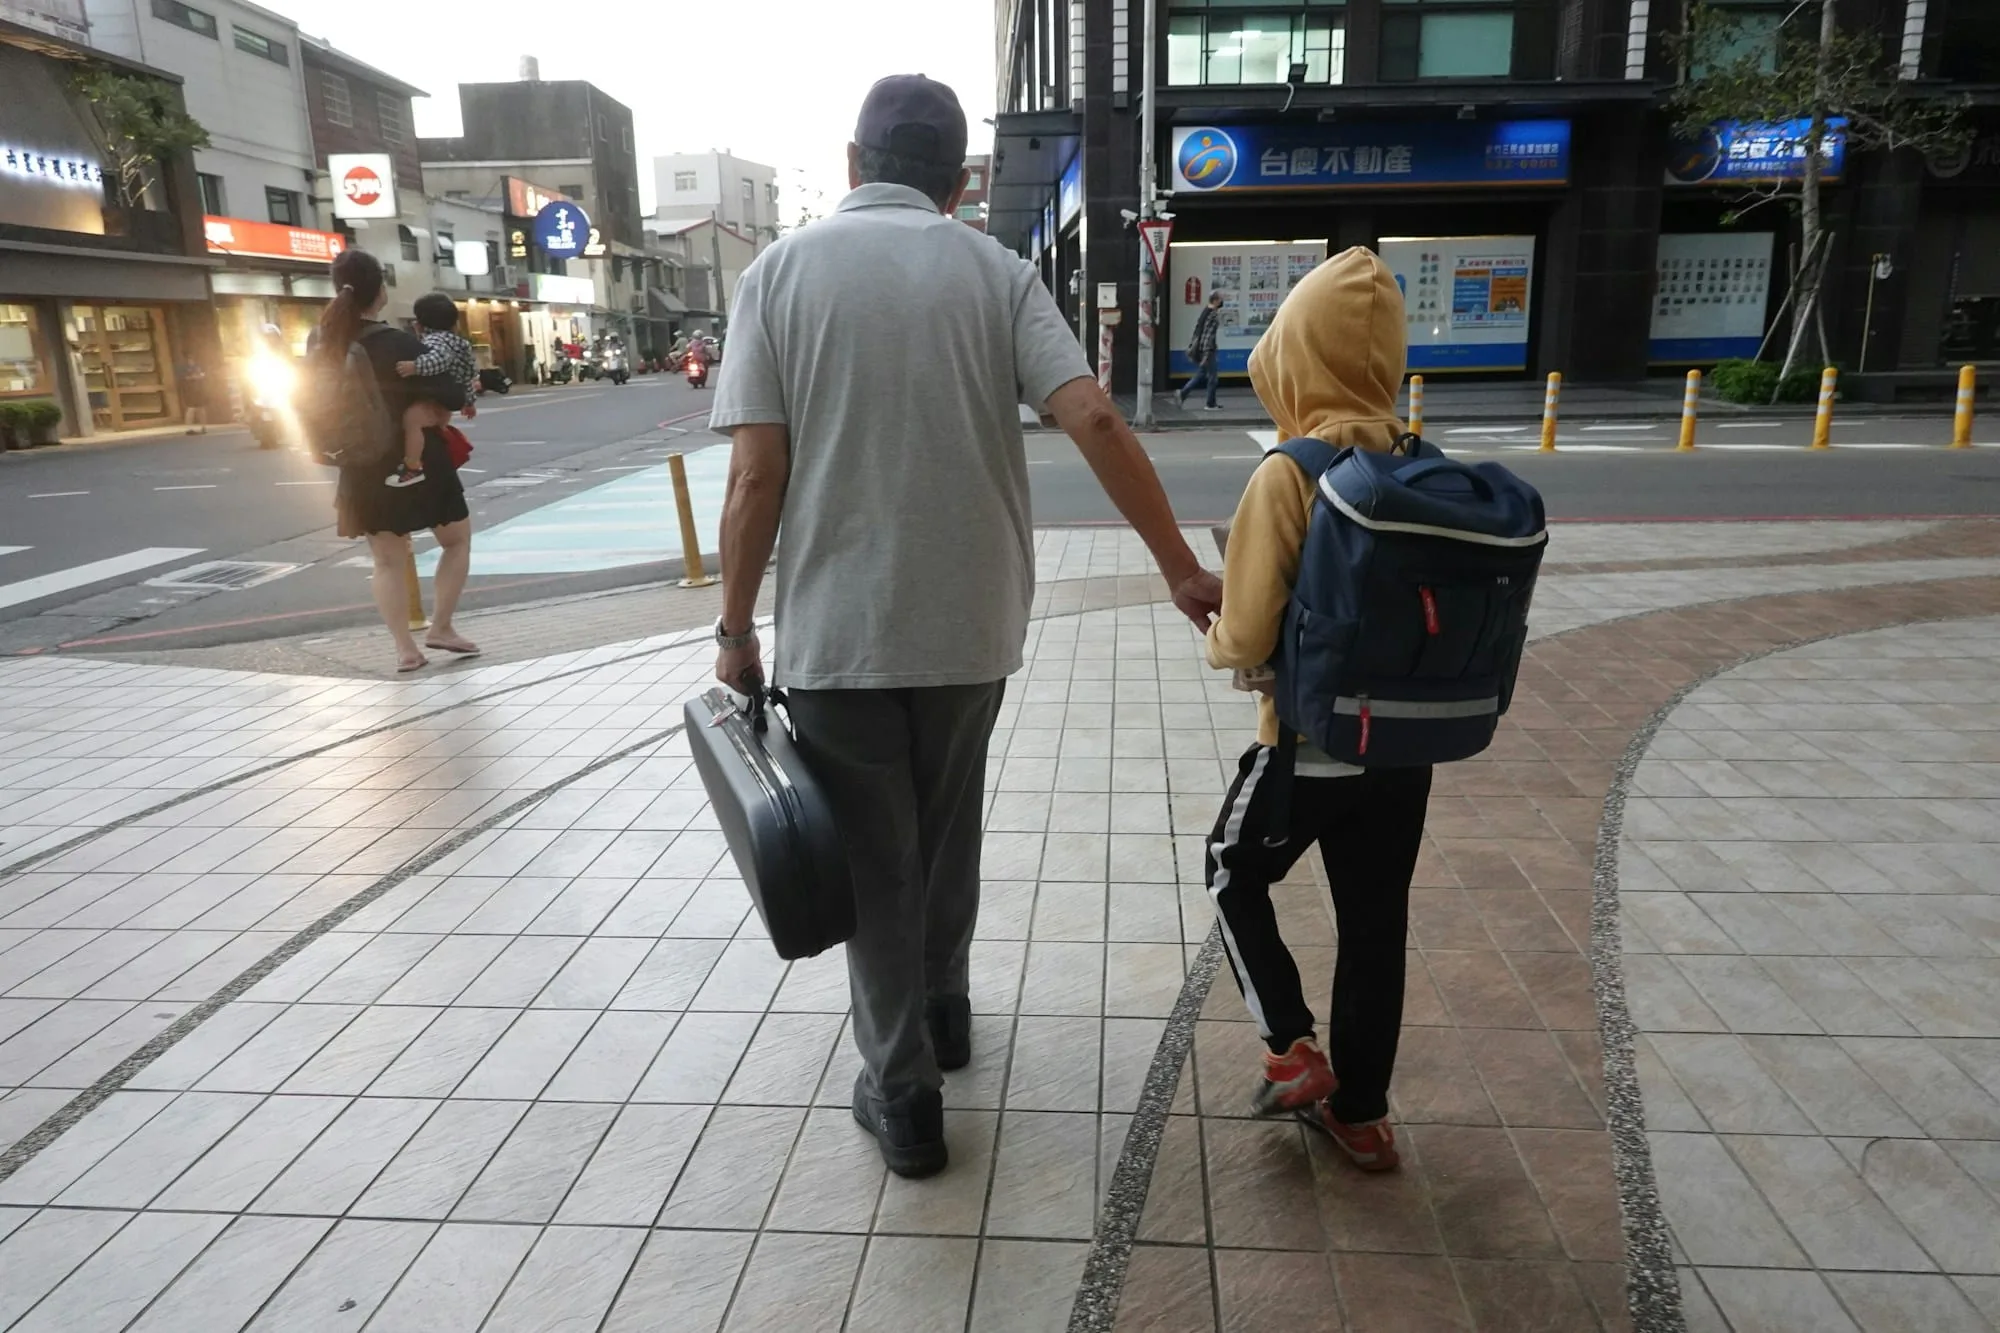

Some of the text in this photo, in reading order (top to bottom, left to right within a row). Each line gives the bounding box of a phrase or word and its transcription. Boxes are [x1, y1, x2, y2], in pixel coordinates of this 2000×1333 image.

[1260, 146, 1413, 176] 台慶不動產
